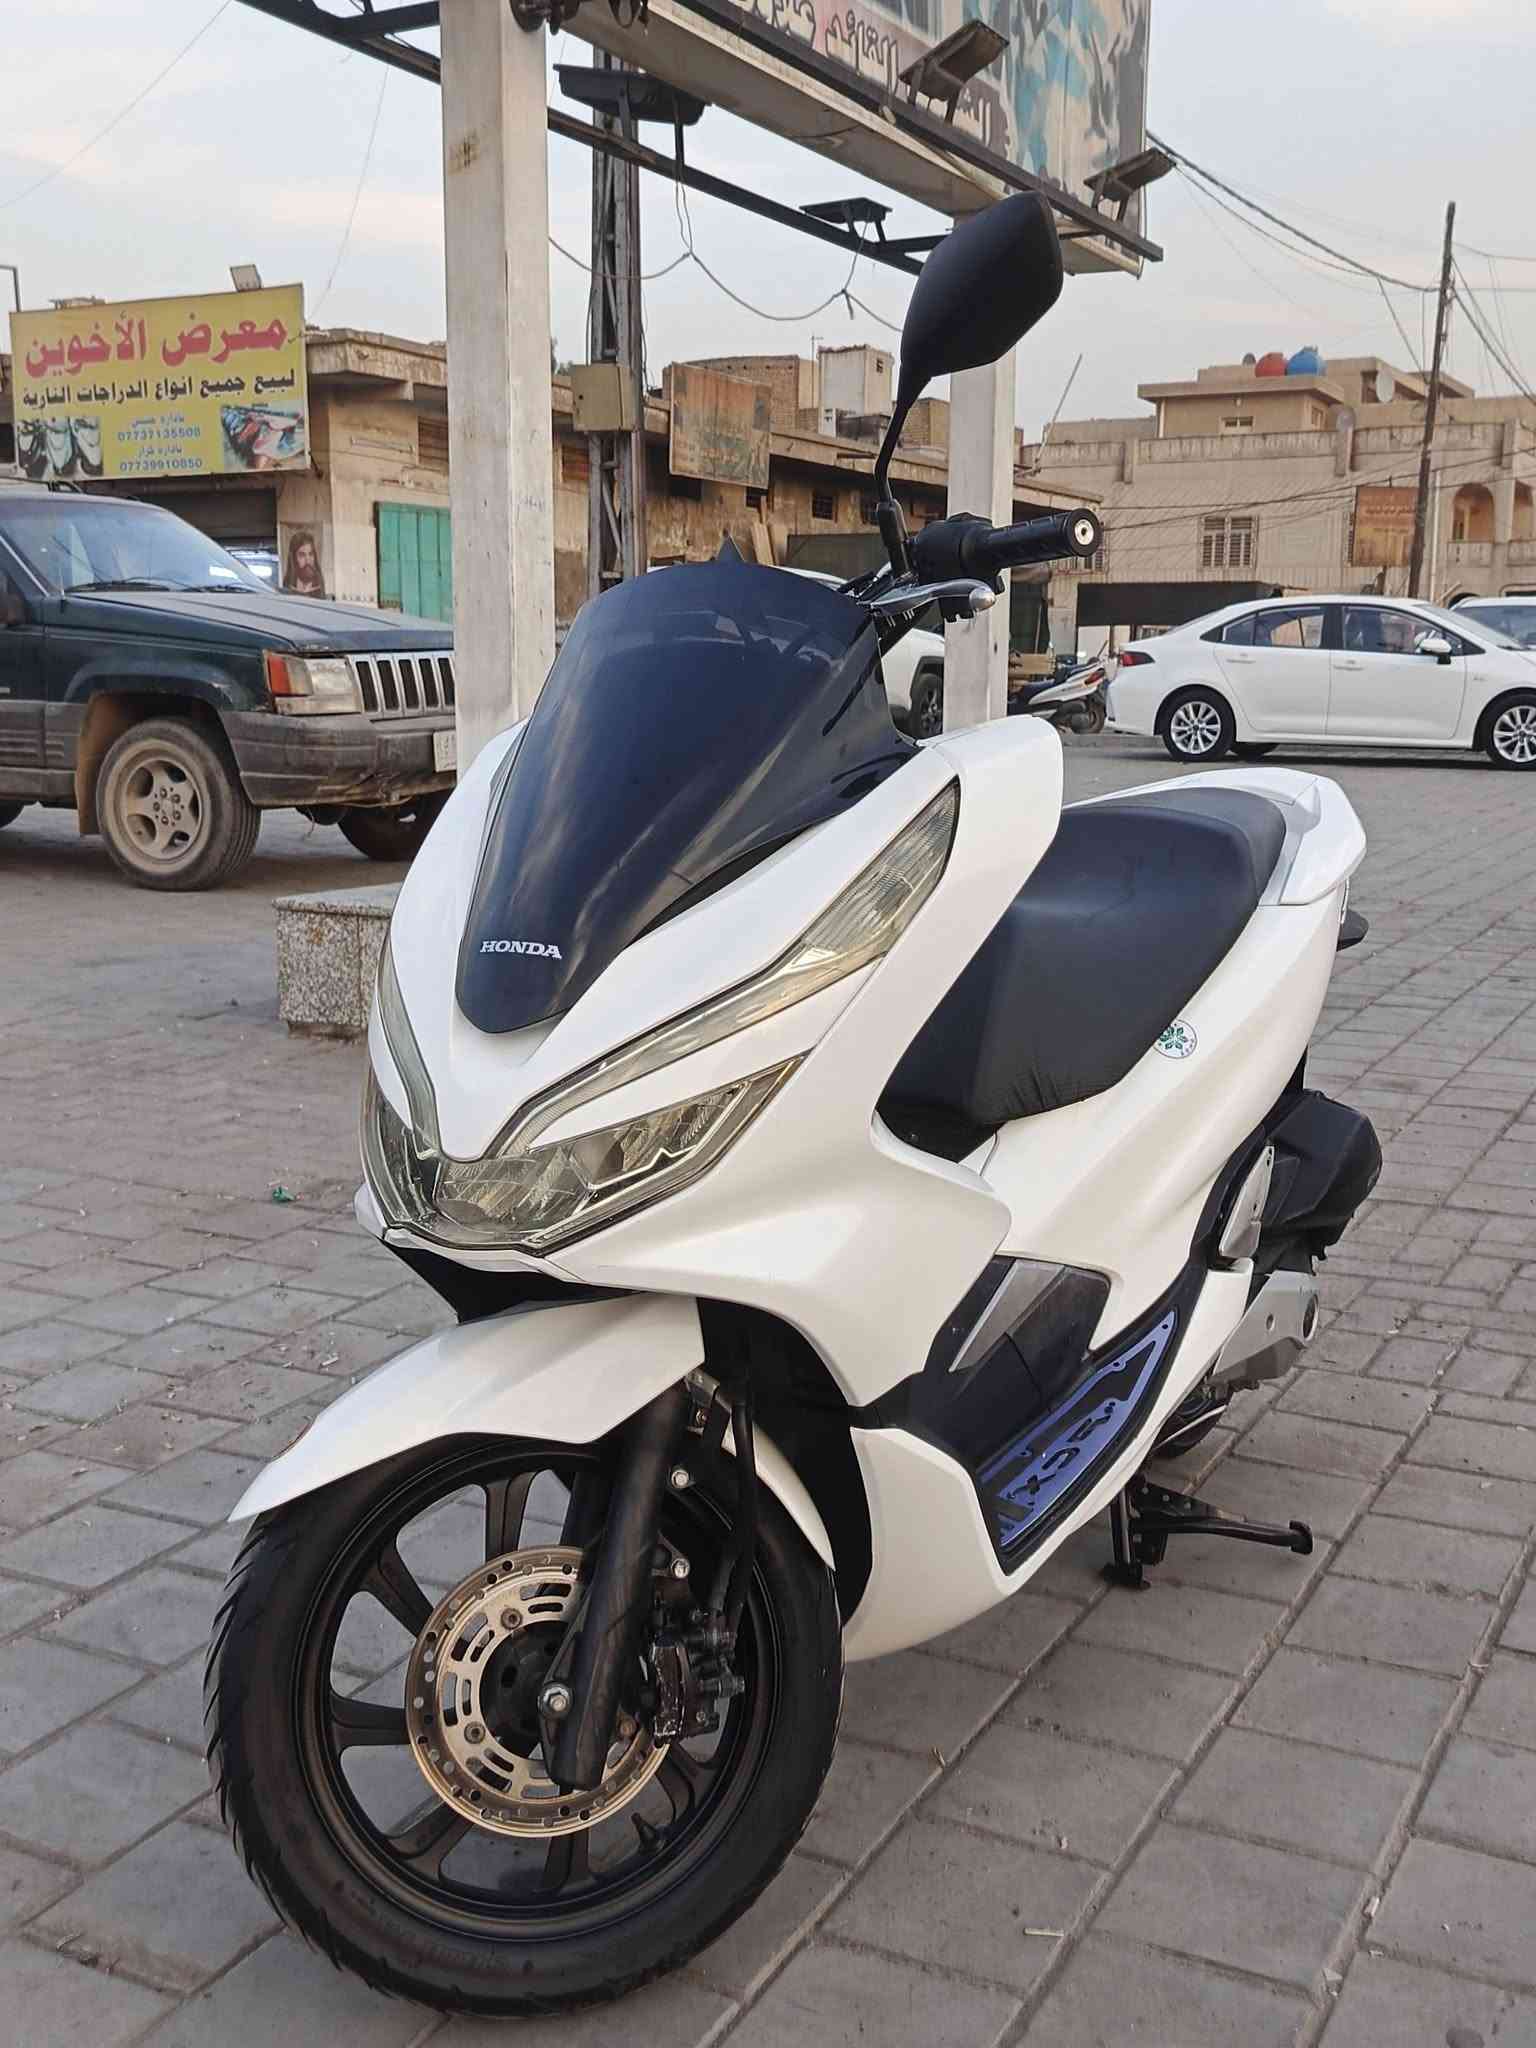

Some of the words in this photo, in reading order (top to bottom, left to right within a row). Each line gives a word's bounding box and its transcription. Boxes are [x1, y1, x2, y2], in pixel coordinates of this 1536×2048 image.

[26, 309, 146, 378] الأخوين
[161, 312, 287, 367] معرض
[77, 379, 147, 405] الدراجات
[155, 376, 192, 400] انواع
[200, 376, 245, 399] جميع
[254, 368, 295, 394] لبيع
[23, 384, 71, 410] النارية
[480, 940, 562, 960] HONDA
